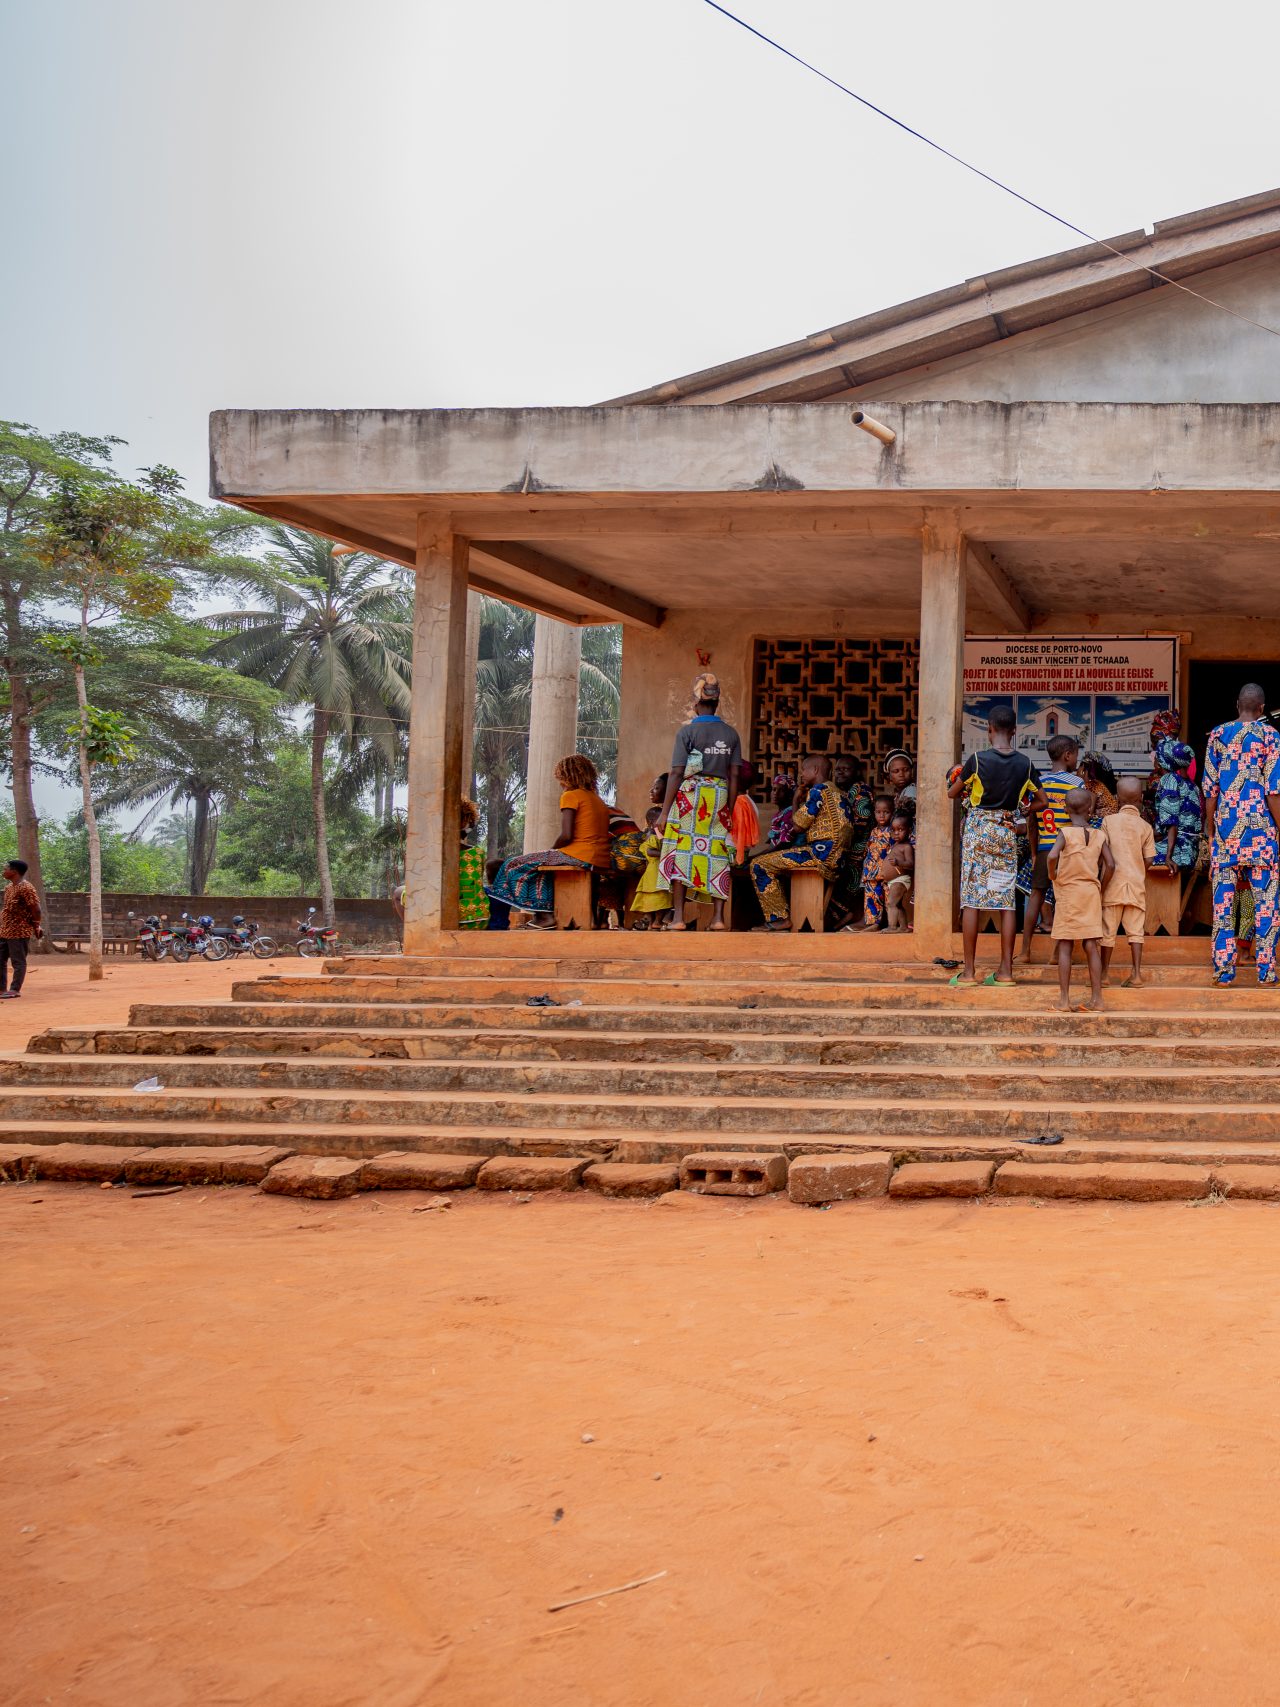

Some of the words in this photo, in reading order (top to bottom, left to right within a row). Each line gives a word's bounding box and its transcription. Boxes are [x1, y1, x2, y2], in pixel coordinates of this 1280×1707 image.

[1006, 645, 1039, 653] DIOCESE
[1041, 645, 1051, 653] DE
[1053, 645, 1103, 653] PORTO-NOVO
[980, 656, 1018, 664] PAROISSE
[1019, 656, 1043, 664] SAINT
[1045, 656, 1079, 664] VINCENT
[1081, 656, 1091, 664] DE
[1093, 656, 1129, 664] TCHAADA
[963, 668, 986, 679] ROJET
[988, 668, 997, 678] DE
[999, 668, 1062, 679] CONSTRUCTION
[1063, 668, 1074, 678] DE
[1075, 668, 1085, 678] LA
[1086, 668, 1126, 678] NOUVELLE
[1127, 668, 1154, 678] EGLISE
[966, 681, 999, 692] STATION
[1000, 681, 1050, 692] SECONDAIRE
[1052, 681, 1076, 691] SAINT
[1078, 681, 1114, 692] JACQUES
[1115, 681, 1125, 691] DE
[1127, 681, 1168, 691] KETOUKPE
[1042, 808, 1057, 834] 8
